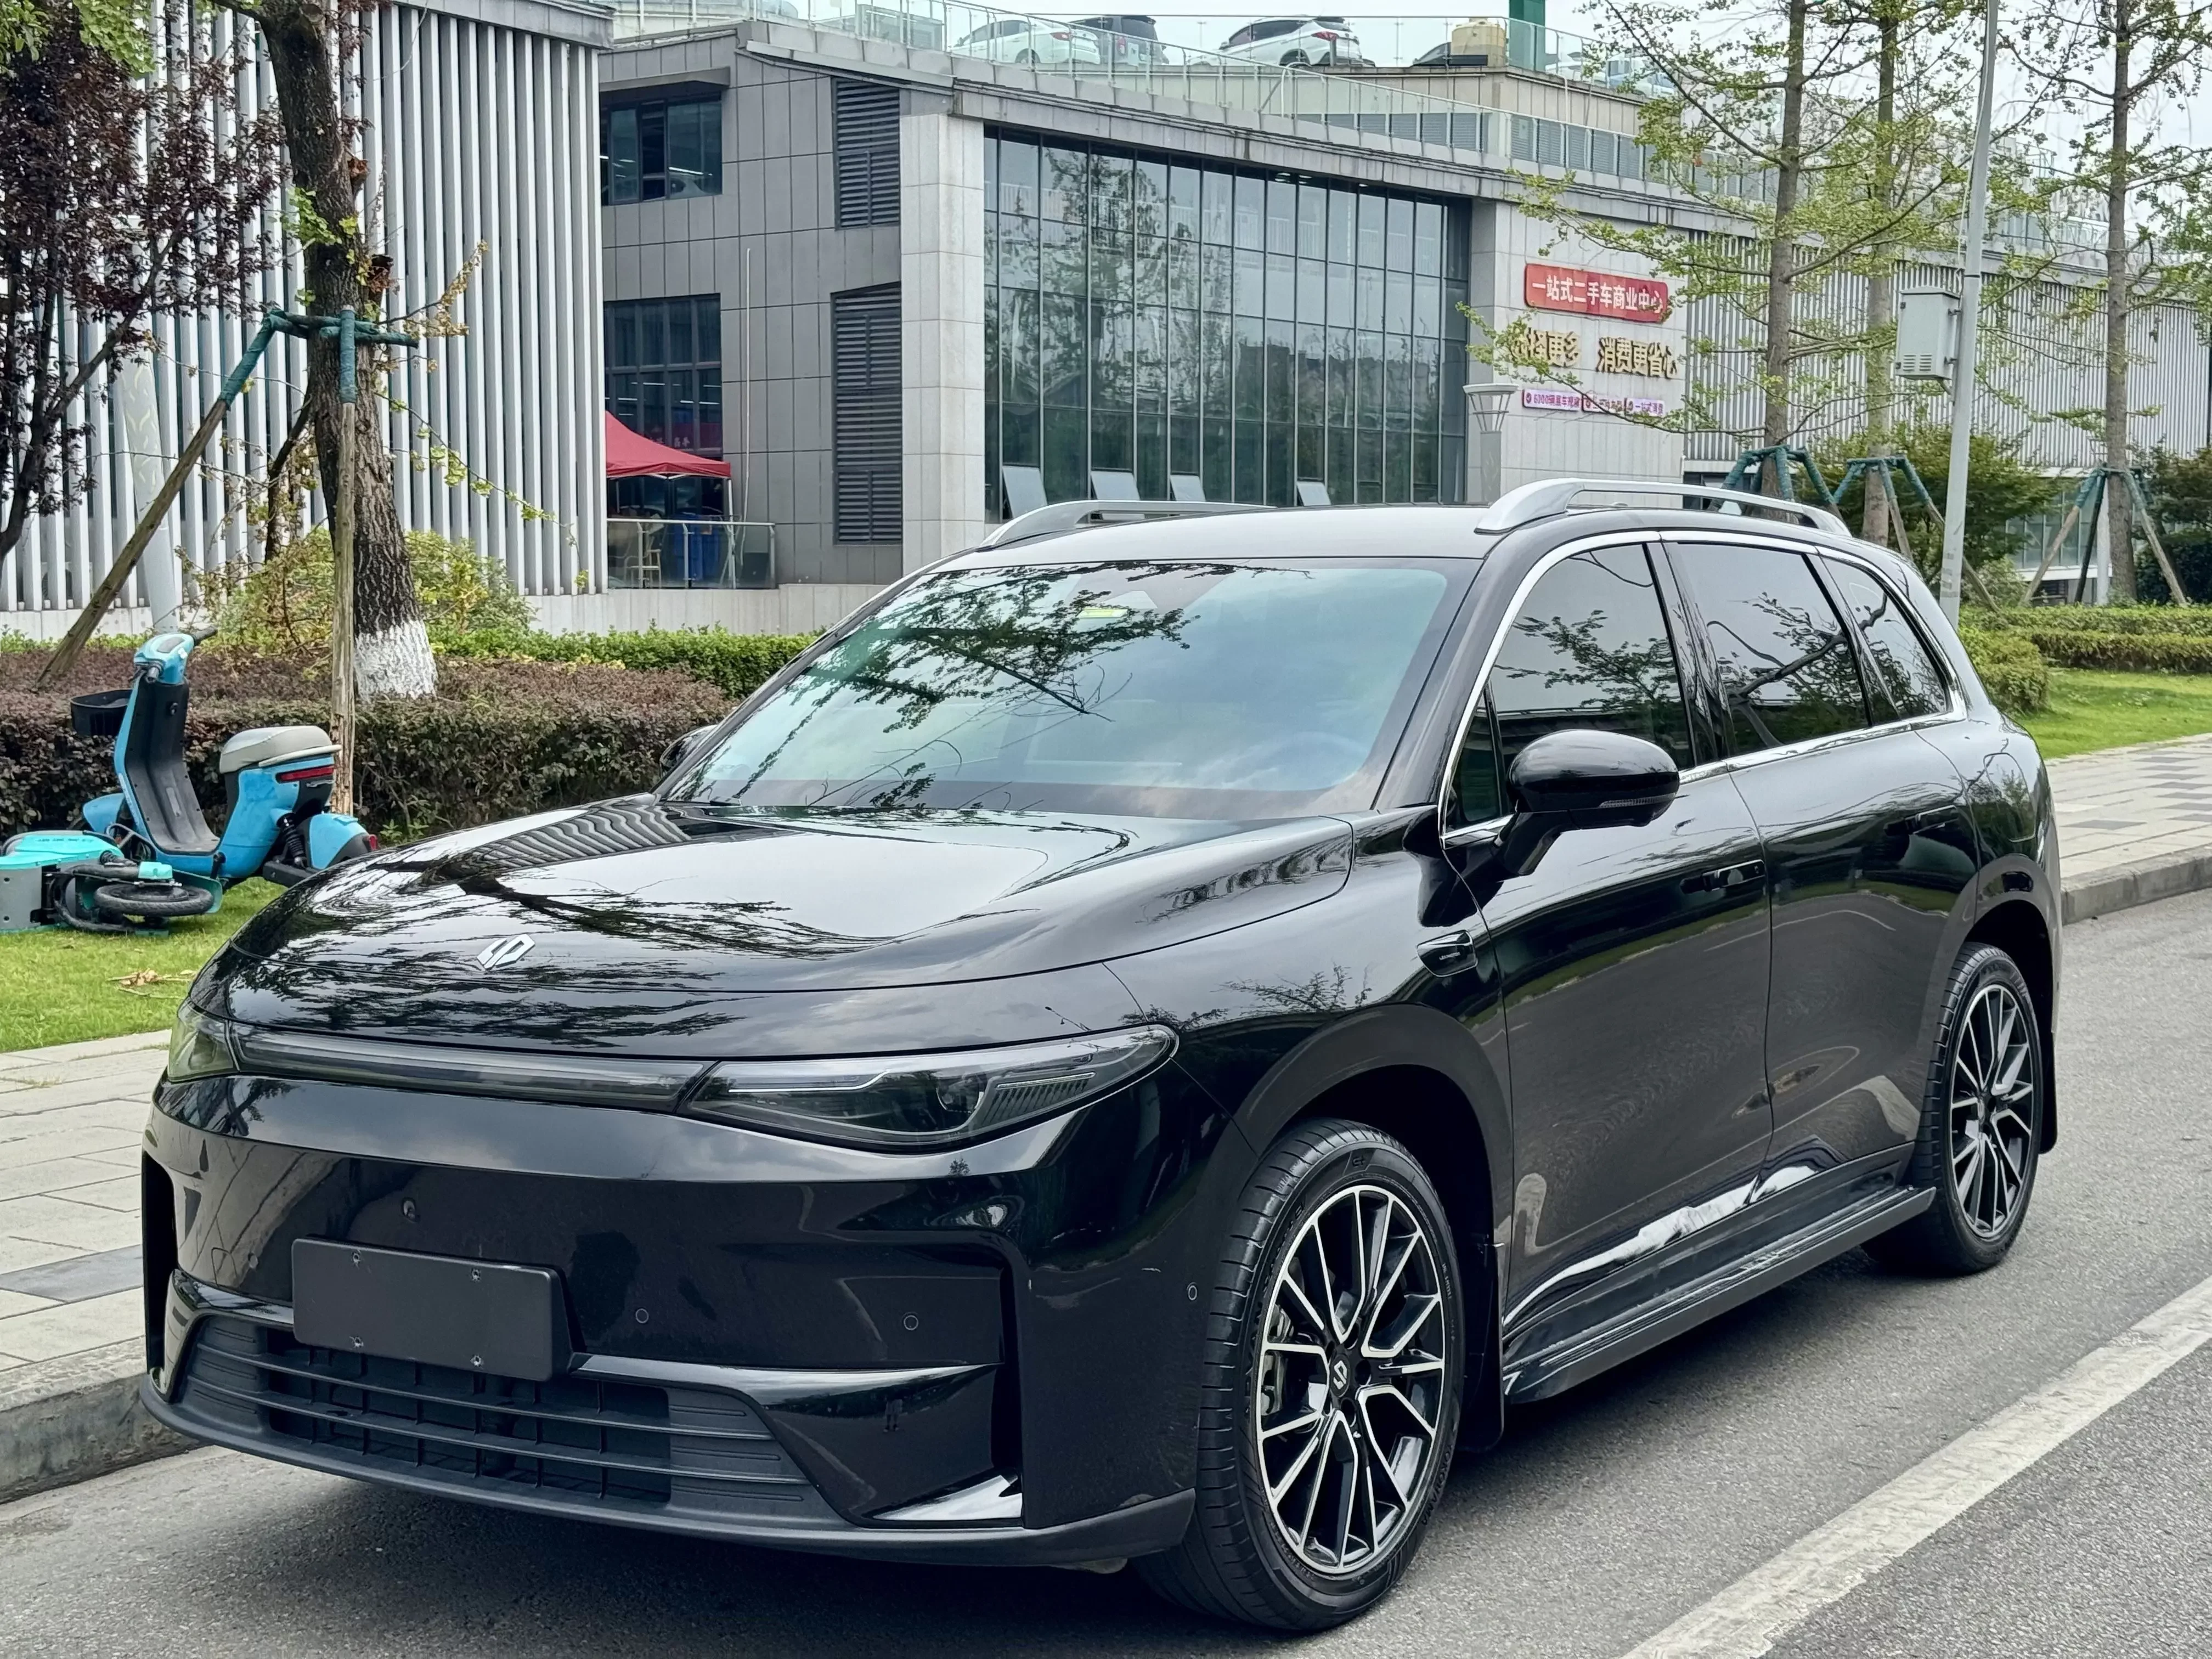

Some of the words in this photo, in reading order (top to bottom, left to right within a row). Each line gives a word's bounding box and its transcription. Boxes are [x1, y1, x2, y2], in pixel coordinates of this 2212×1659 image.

[1532, 275, 1663, 313] 一站式二手车商业中心
[1596, 336, 1677, 379] 消费更省心
[1421, 1443, 1452, 1526] YOKOHAMA
